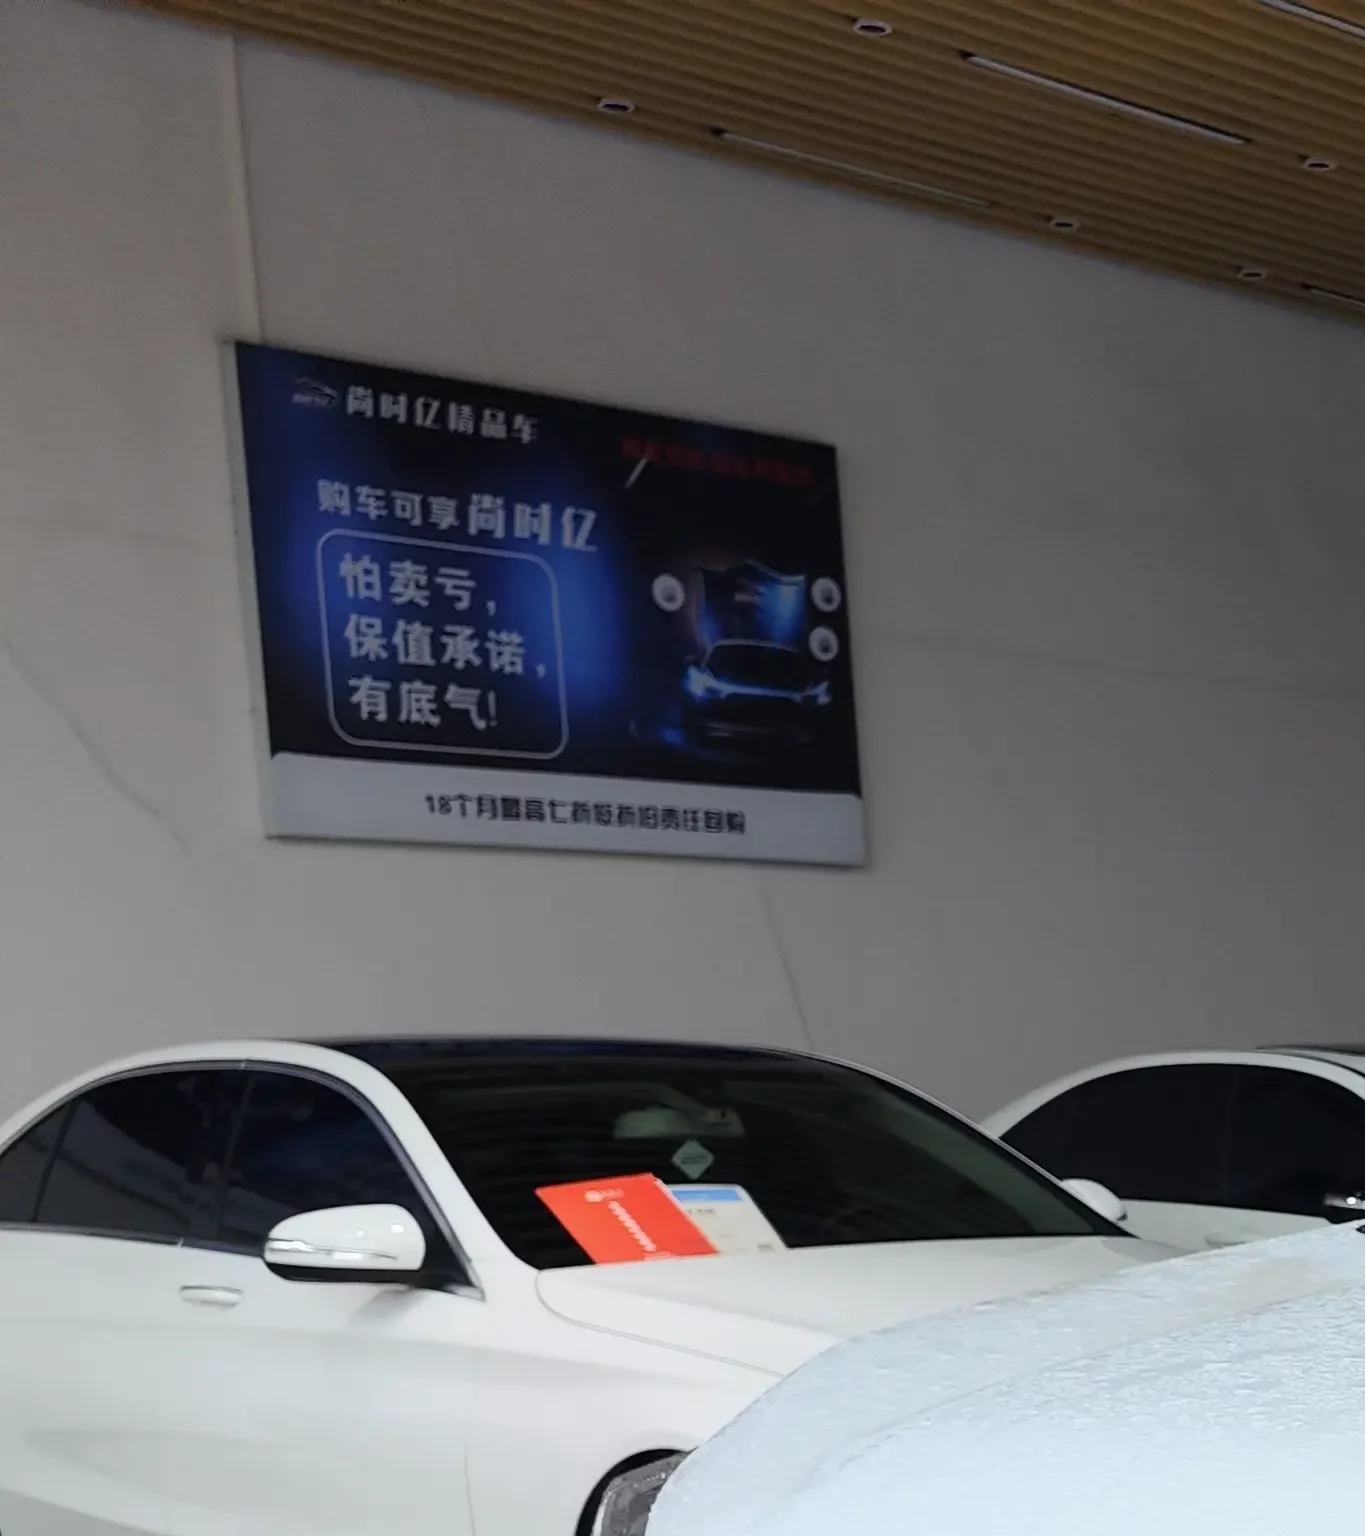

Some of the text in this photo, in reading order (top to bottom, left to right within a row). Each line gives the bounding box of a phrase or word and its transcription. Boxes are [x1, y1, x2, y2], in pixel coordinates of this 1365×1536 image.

[345, 383, 541, 444] 尚时亿精品车
[318, 478, 598, 553] 购车可享尚时亿
